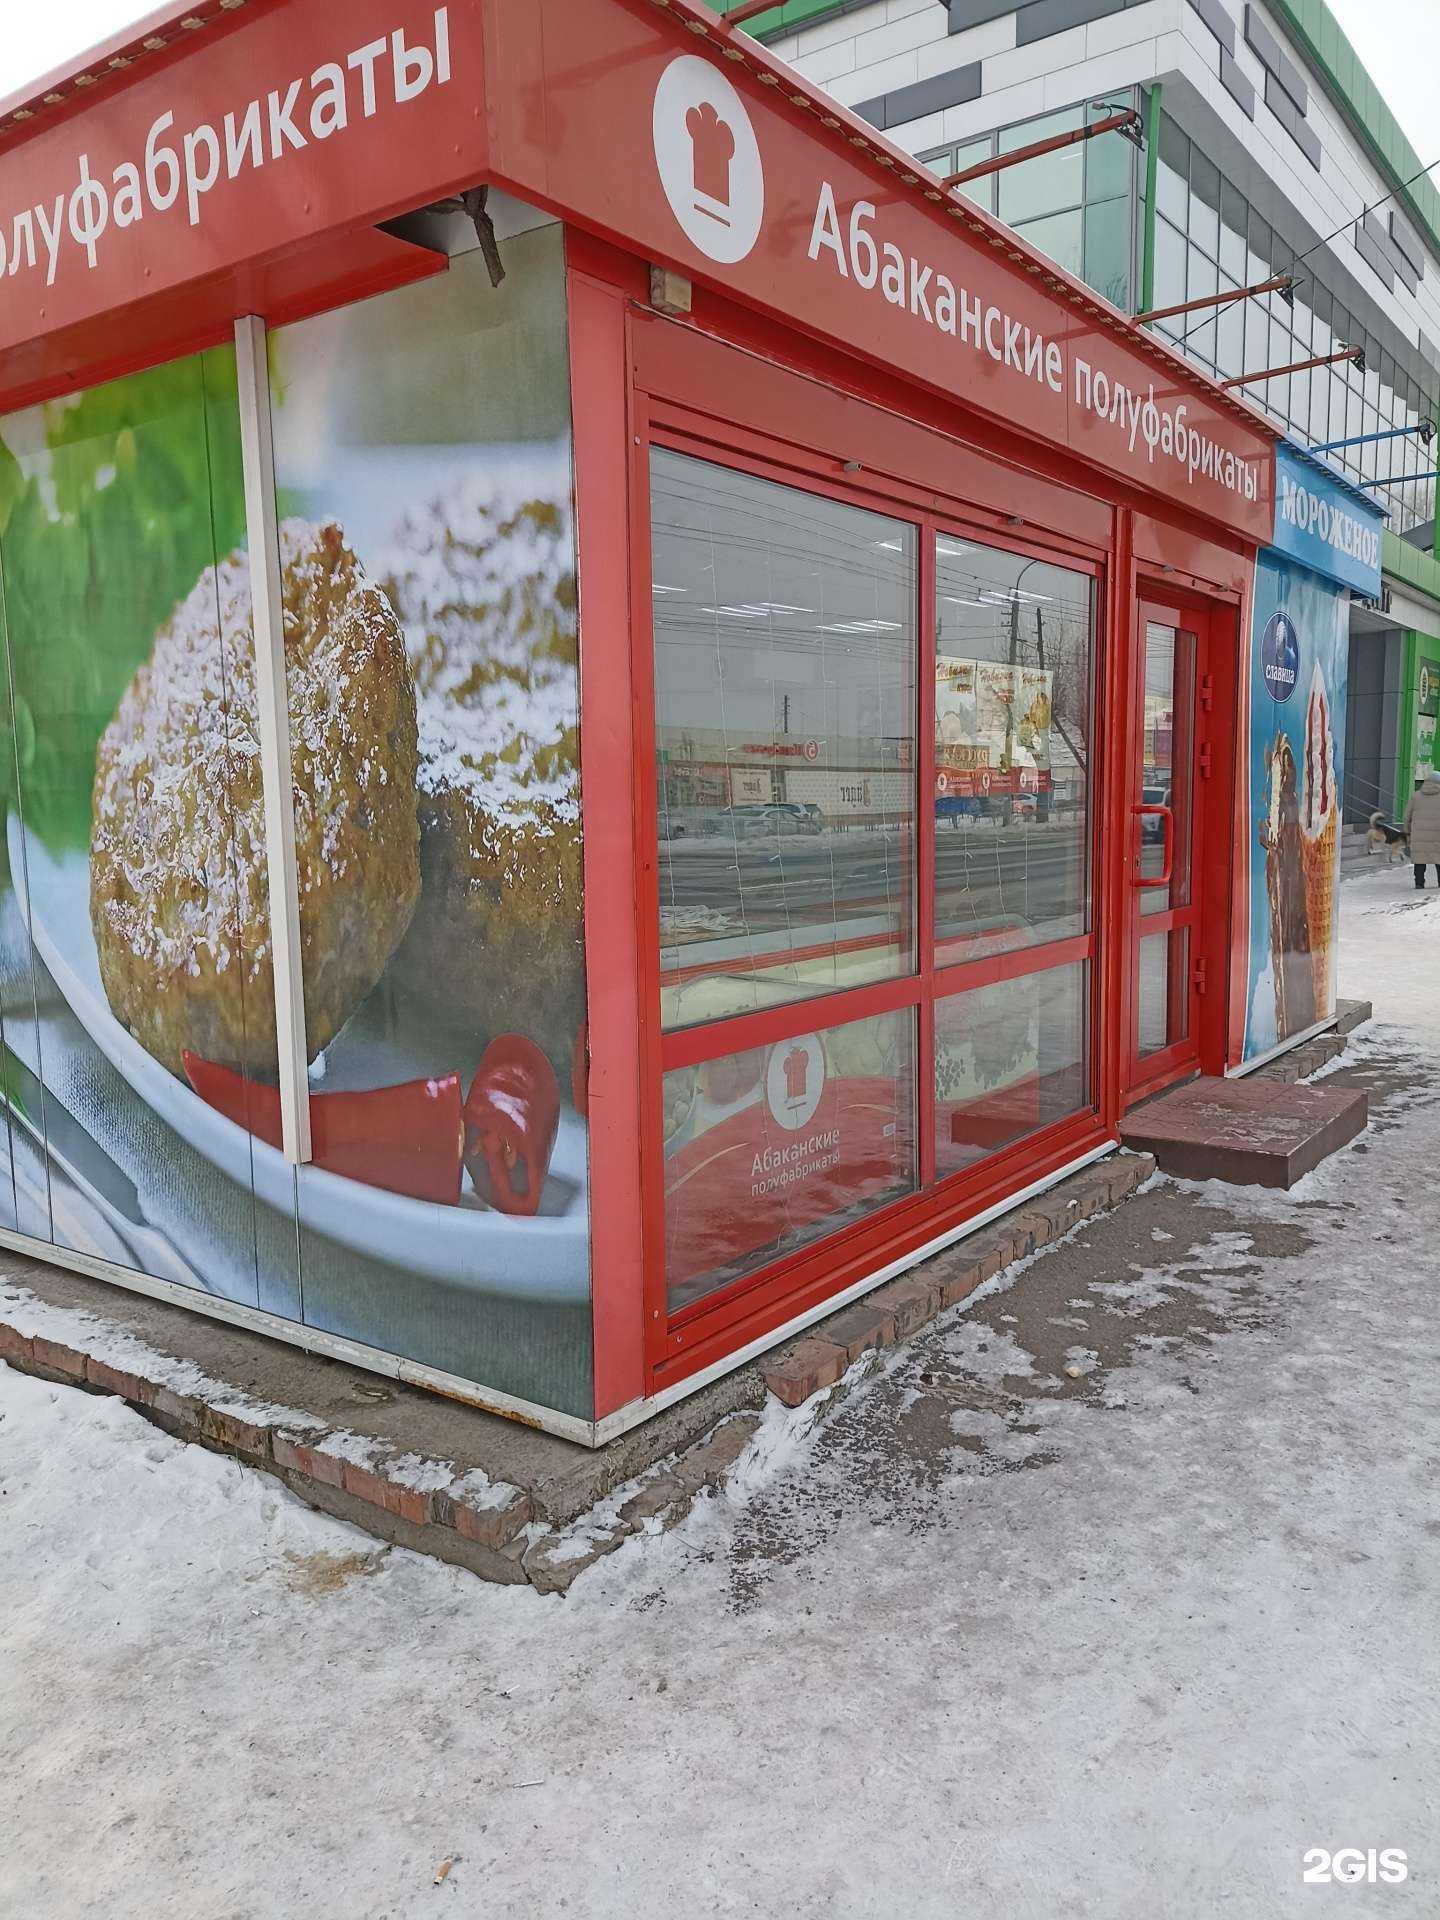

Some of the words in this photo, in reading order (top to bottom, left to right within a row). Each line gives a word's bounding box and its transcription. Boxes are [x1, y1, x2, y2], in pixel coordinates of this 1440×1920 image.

[0, 7, 451, 287] луфабрикаты
[807, 180, 1063, 393] Абаканские
[1075, 357, 1257, 502] полуфабрикаты
[1281, 475, 1379, 570] МОРОЖЕНОЕ
[751, 1129, 840, 1176] Абаканские
[751, 1151, 840, 1197] полуфабрикаты
